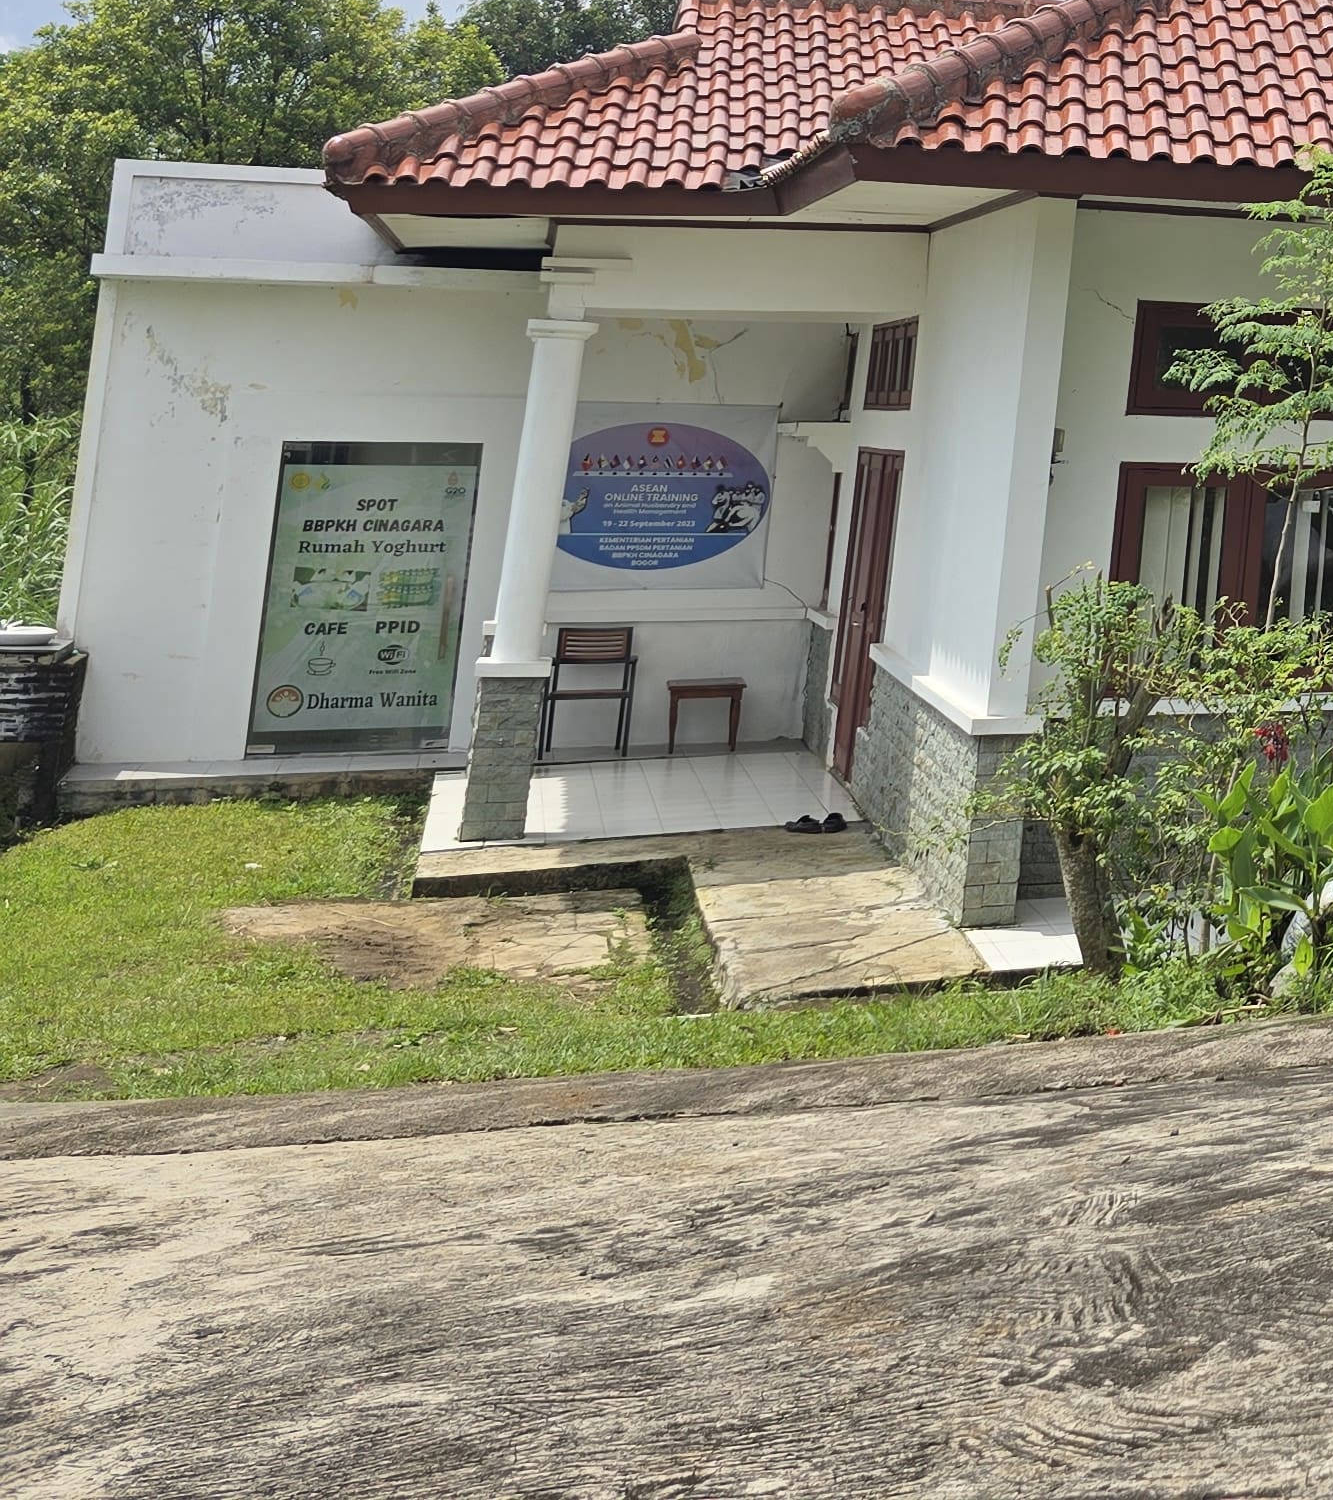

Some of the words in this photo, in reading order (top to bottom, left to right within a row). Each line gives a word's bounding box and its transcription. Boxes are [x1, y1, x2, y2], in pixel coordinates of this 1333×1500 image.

[630, 484, 668, 493] ASEAN
[604, 492, 645, 502] ONLINE
[647, 493, 699, 502] TRAINING
[356, 498, 398, 512] SPOT
[638, 508, 687, 516] Management
[641, 502, 681, 510] Husbandry
[302, 519, 357, 533] BBPKH
[362, 519, 445, 532] CINAGARA
[629, 520, 675, 529] September
[298, 539, 365, 554] Rumah
[372, 539, 447, 557] Yoghurt
[304, 621, 349, 636] CAFE
[375, 620, 421, 635] PPID
[306, 691, 374, 710] Dharma
[379, 690, 439, 708] Wanita
